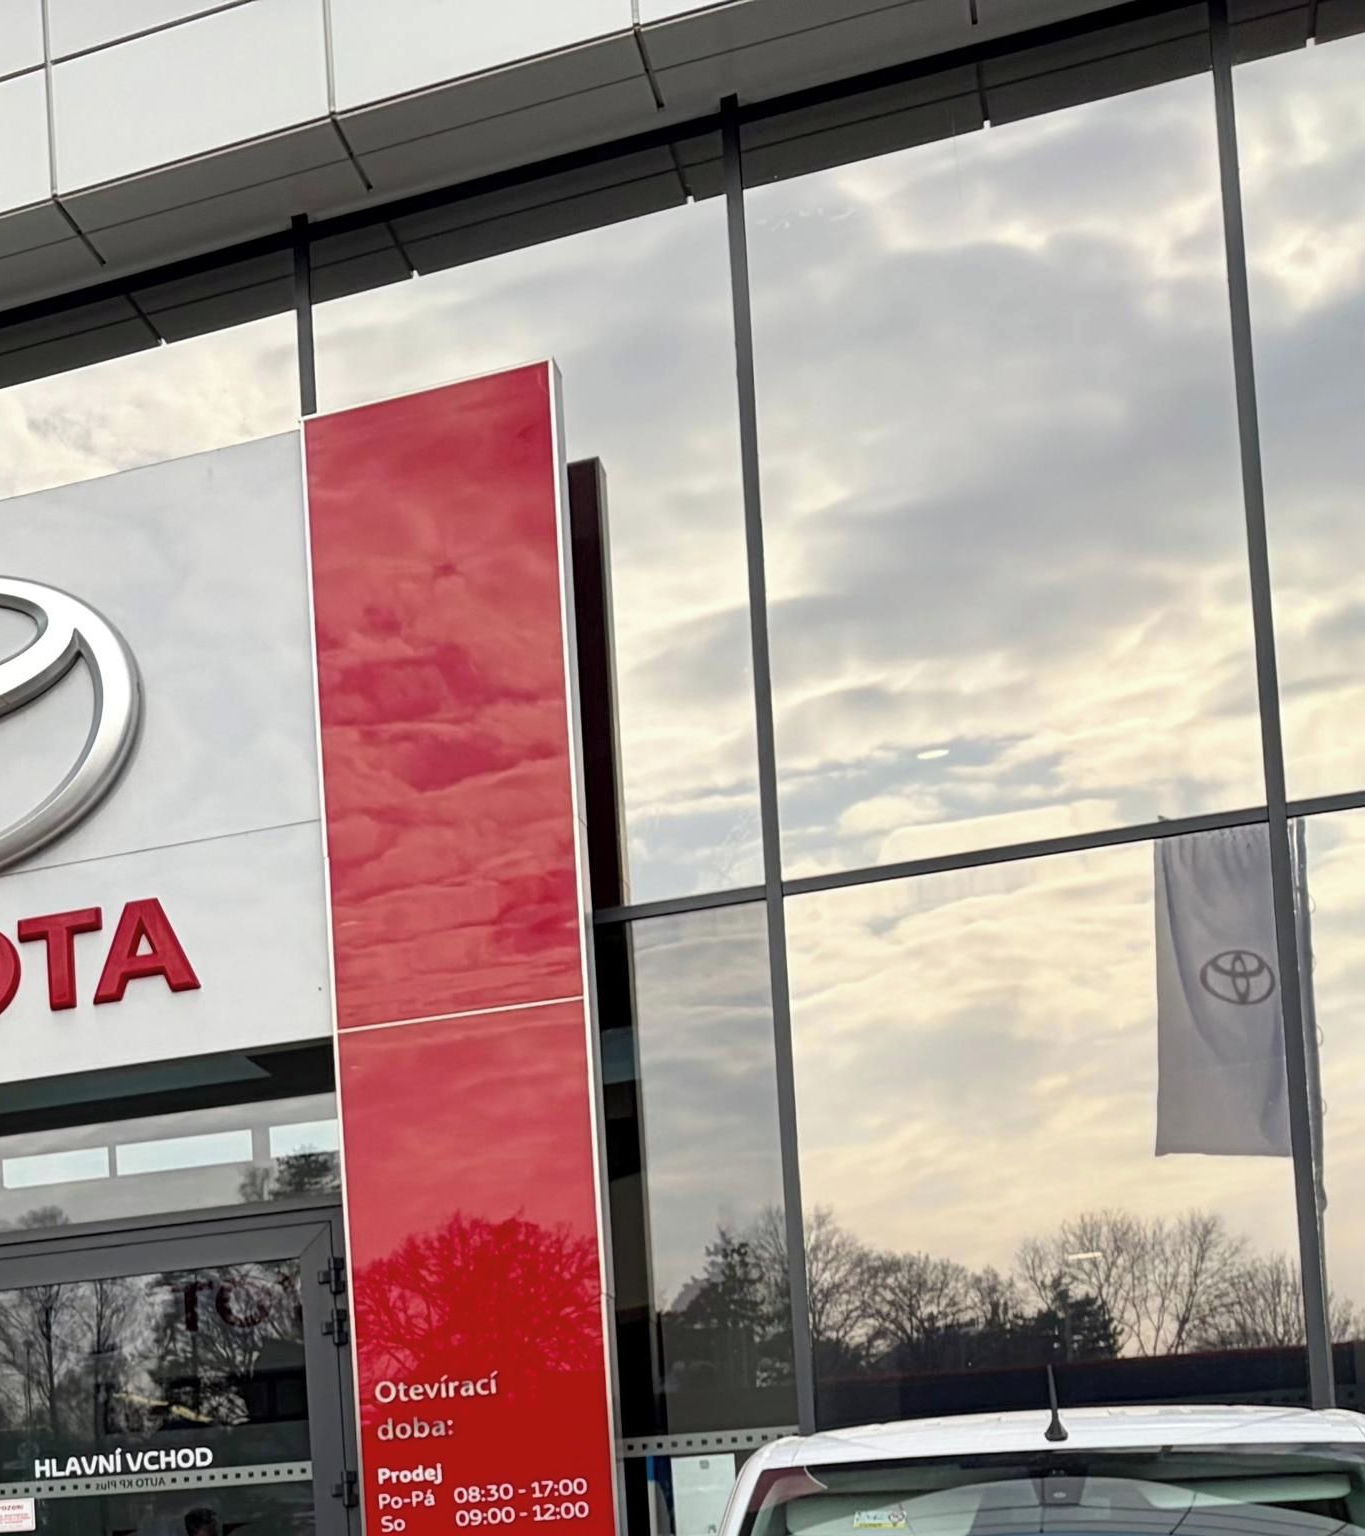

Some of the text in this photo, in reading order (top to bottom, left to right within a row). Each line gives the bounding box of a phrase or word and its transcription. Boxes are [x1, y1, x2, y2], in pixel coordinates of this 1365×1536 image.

[374, 1371, 499, 1403] Otevírací
[377, 1417, 454, 1441] doba:
[34, 1447, 213, 1479] HLAVNÍ VCHOD
[377, 1463, 443, 1485] Prodej
[378, 1489, 436, 1510] Po-Pá
[453, 1482, 514, 1504] 08:30
[531, 1478, 588, 1499] 17:00
[380, 1515, 406, 1533] So
[455, 1506, 516, 1527] 09:00
[532, 1501, 589, 1522] 12:00
